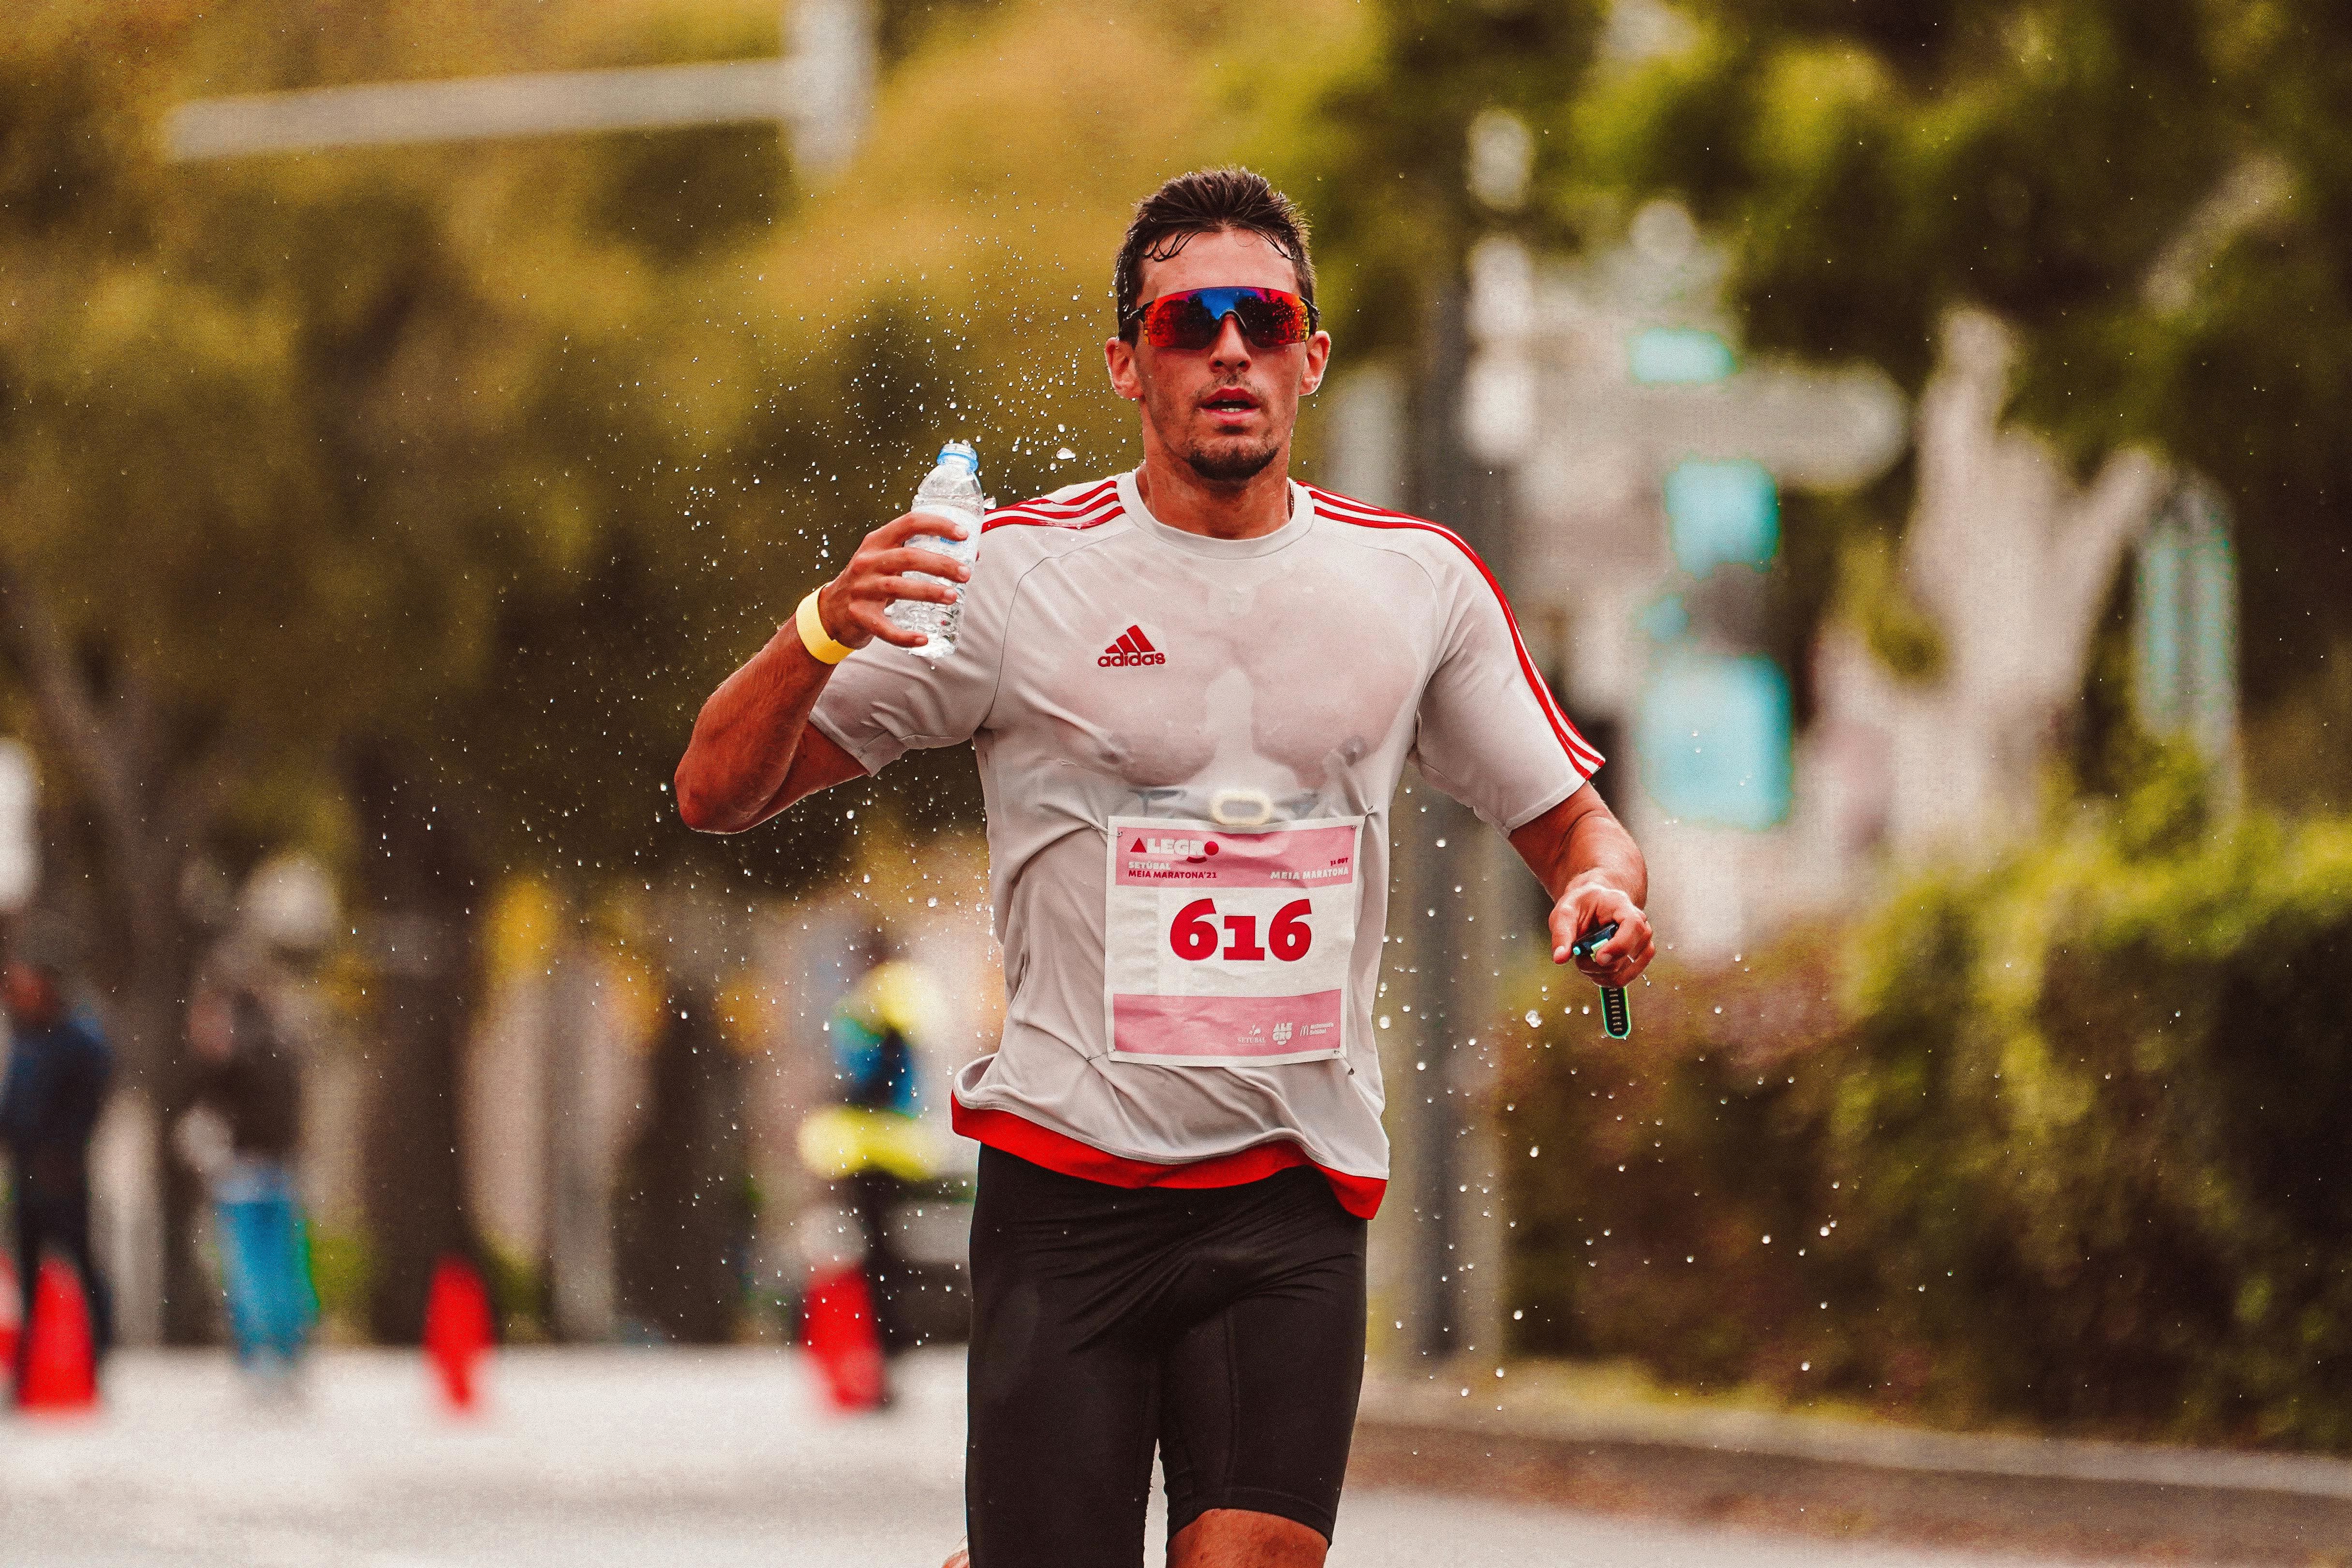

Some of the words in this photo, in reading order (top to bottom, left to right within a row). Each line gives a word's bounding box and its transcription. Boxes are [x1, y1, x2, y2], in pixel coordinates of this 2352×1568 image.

[1097, 652, 1165, 667] adidas
[1271, 872, 1300, 880] MEIA
[1302, 867, 1348, 879] MARATONA
[1170, 898, 1312, 961] 616
